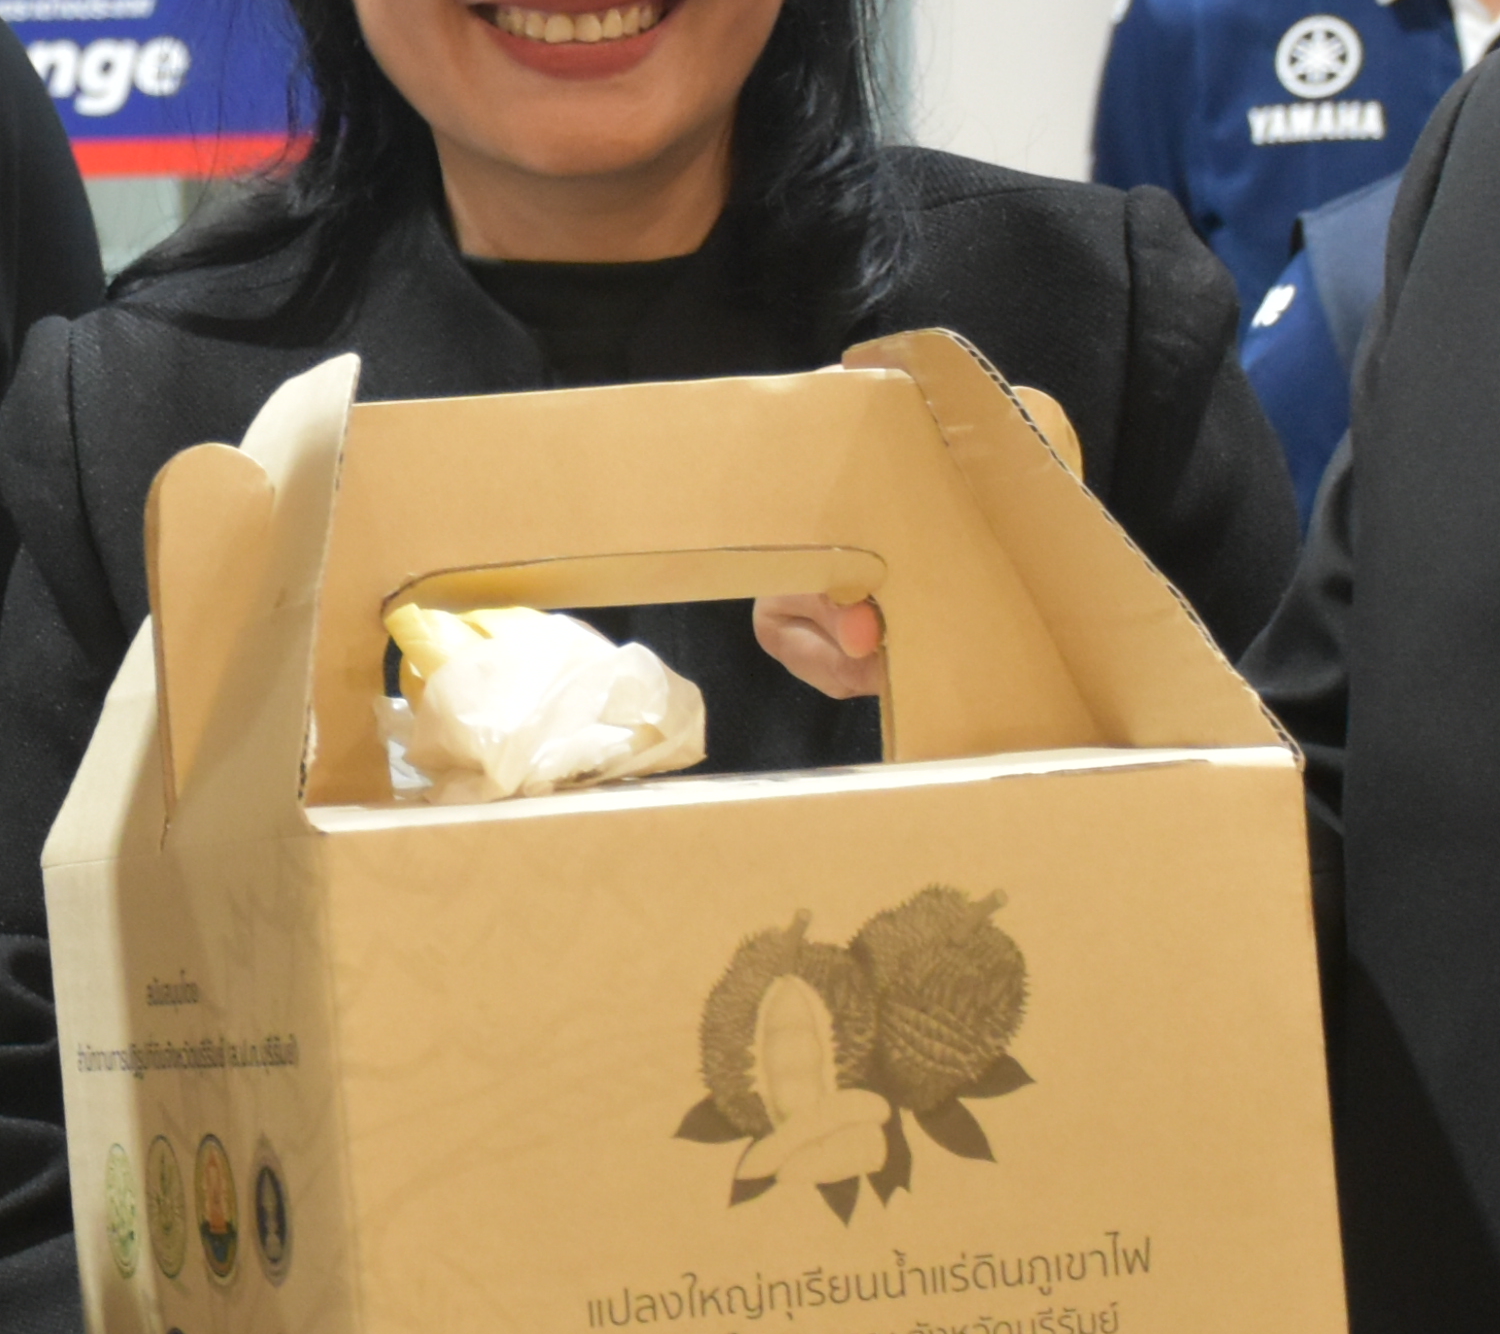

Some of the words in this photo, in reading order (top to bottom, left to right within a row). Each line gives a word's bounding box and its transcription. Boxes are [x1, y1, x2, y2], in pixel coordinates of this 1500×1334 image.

[1247, 100, 1387, 145] YAMAHA
[586, 1232, 1153, 1328] แปลงใหญ่ทุเรียนน้ำแร่ดินภูเขาไฟ
